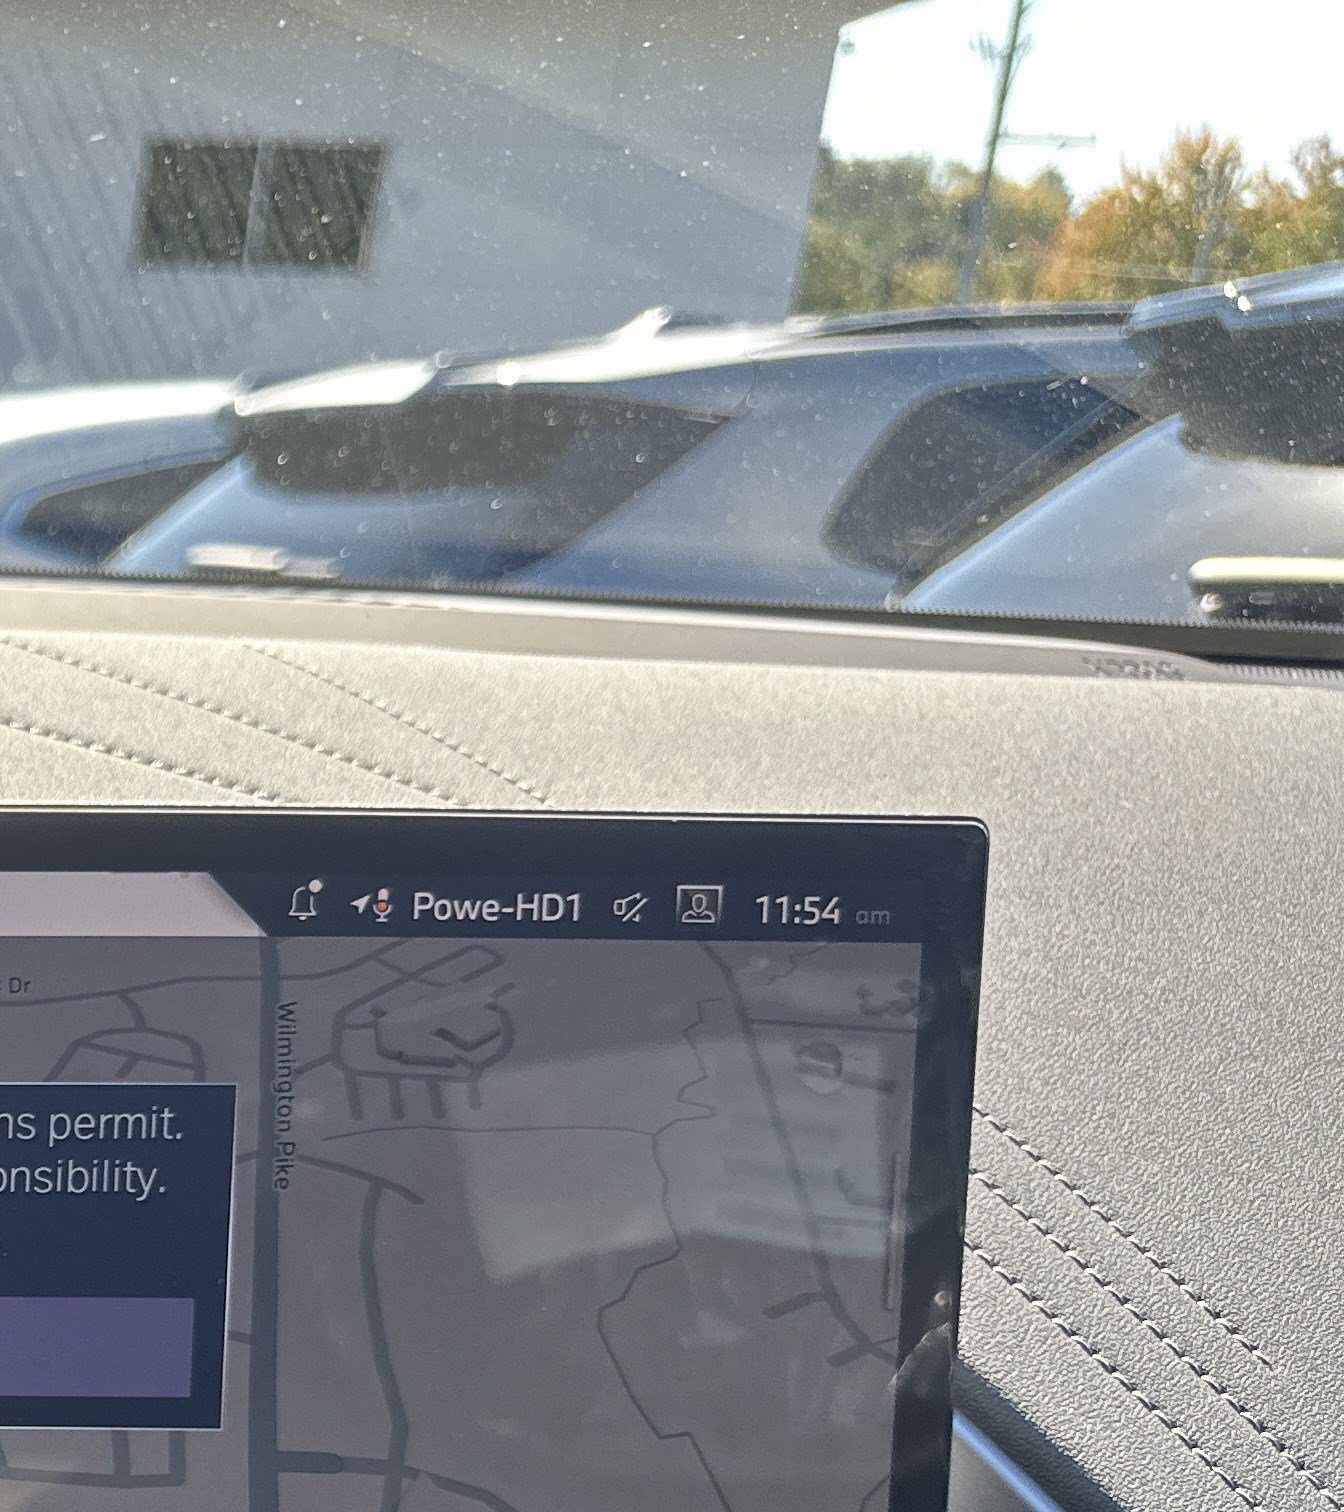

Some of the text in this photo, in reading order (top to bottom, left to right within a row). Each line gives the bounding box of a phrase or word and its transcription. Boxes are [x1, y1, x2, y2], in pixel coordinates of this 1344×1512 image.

[412, 892, 582, 923] Powe-HD1
[755, 894, 891, 926] 11:54 am
[8, 977, 31, 994] Dr
[272, 1001, 298, 1191] Wilmington Pike
[48, 1105, 183, 1147] permit.
